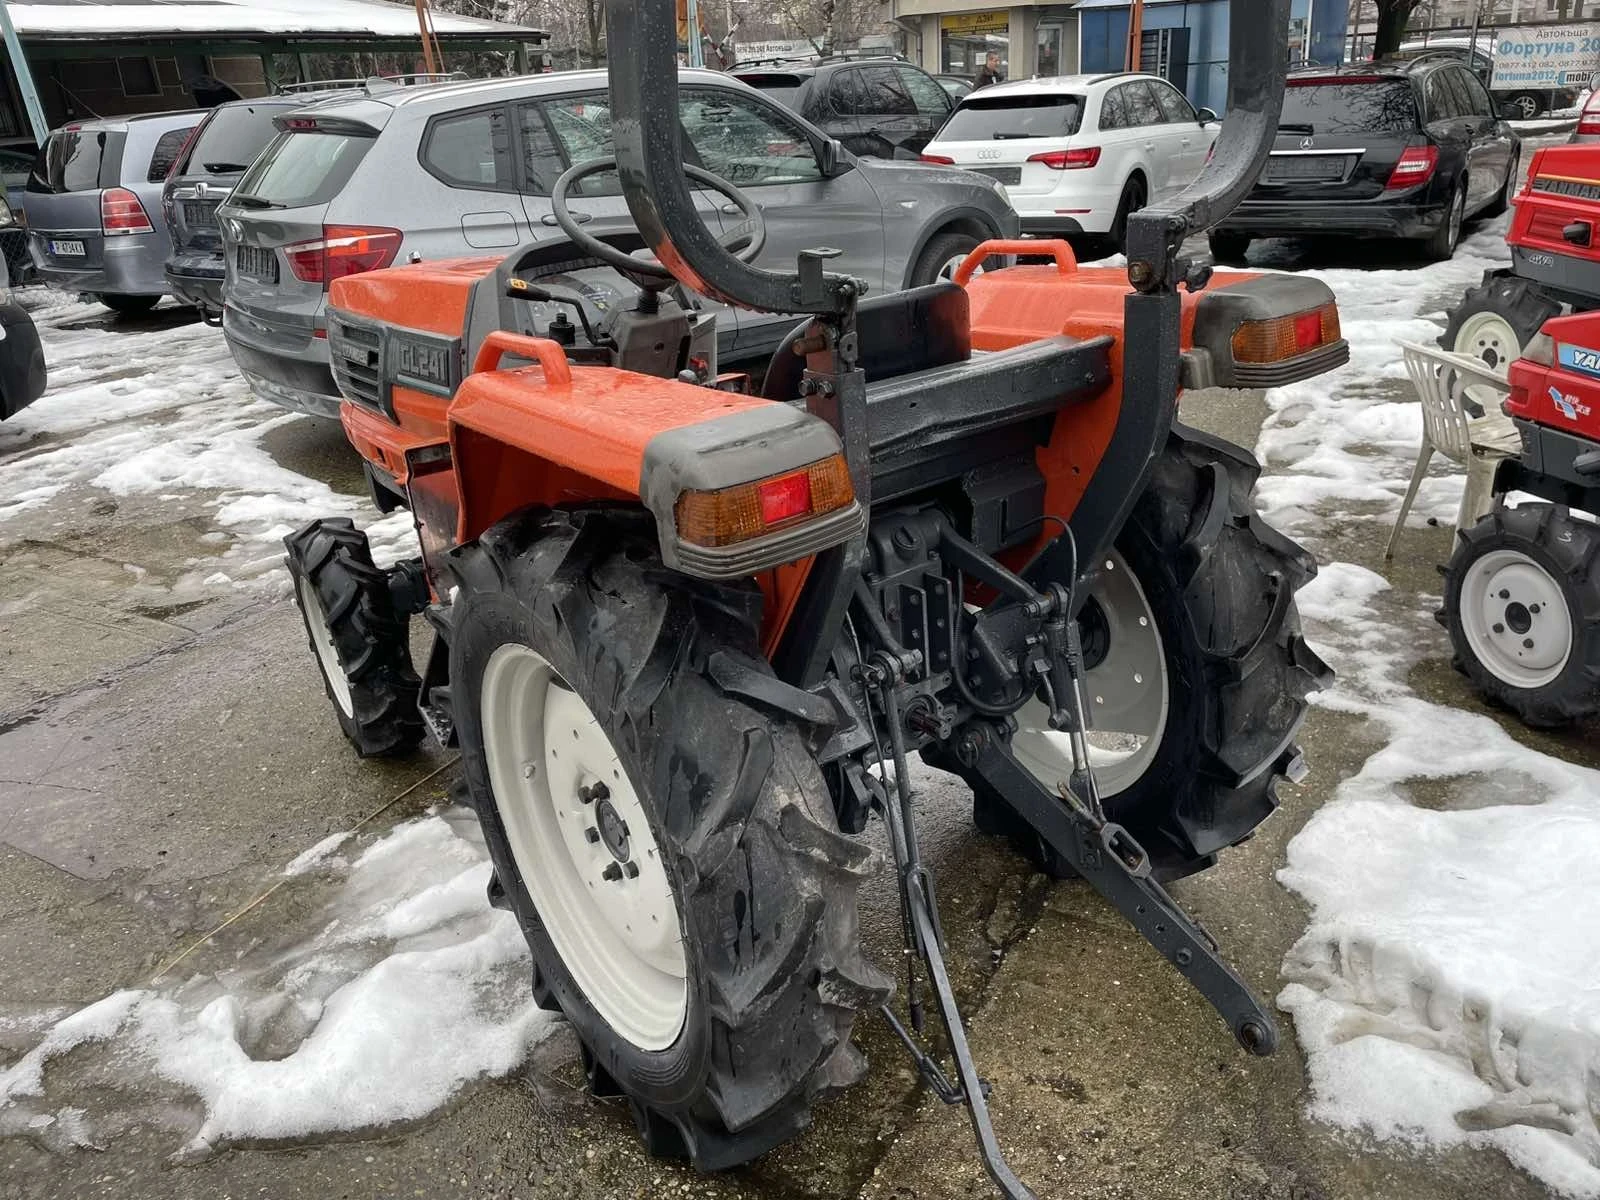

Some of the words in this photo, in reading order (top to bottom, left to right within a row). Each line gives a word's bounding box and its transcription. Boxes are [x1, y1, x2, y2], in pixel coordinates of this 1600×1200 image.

[976, 14, 993, 24] ДЗИ
[1536, 29, 1589, 38] Автокъща
[1498, 40, 1575, 58] Фортуна
[1532, 178, 1600, 200] YANMAR
[399, 344, 447, 381] GL241
